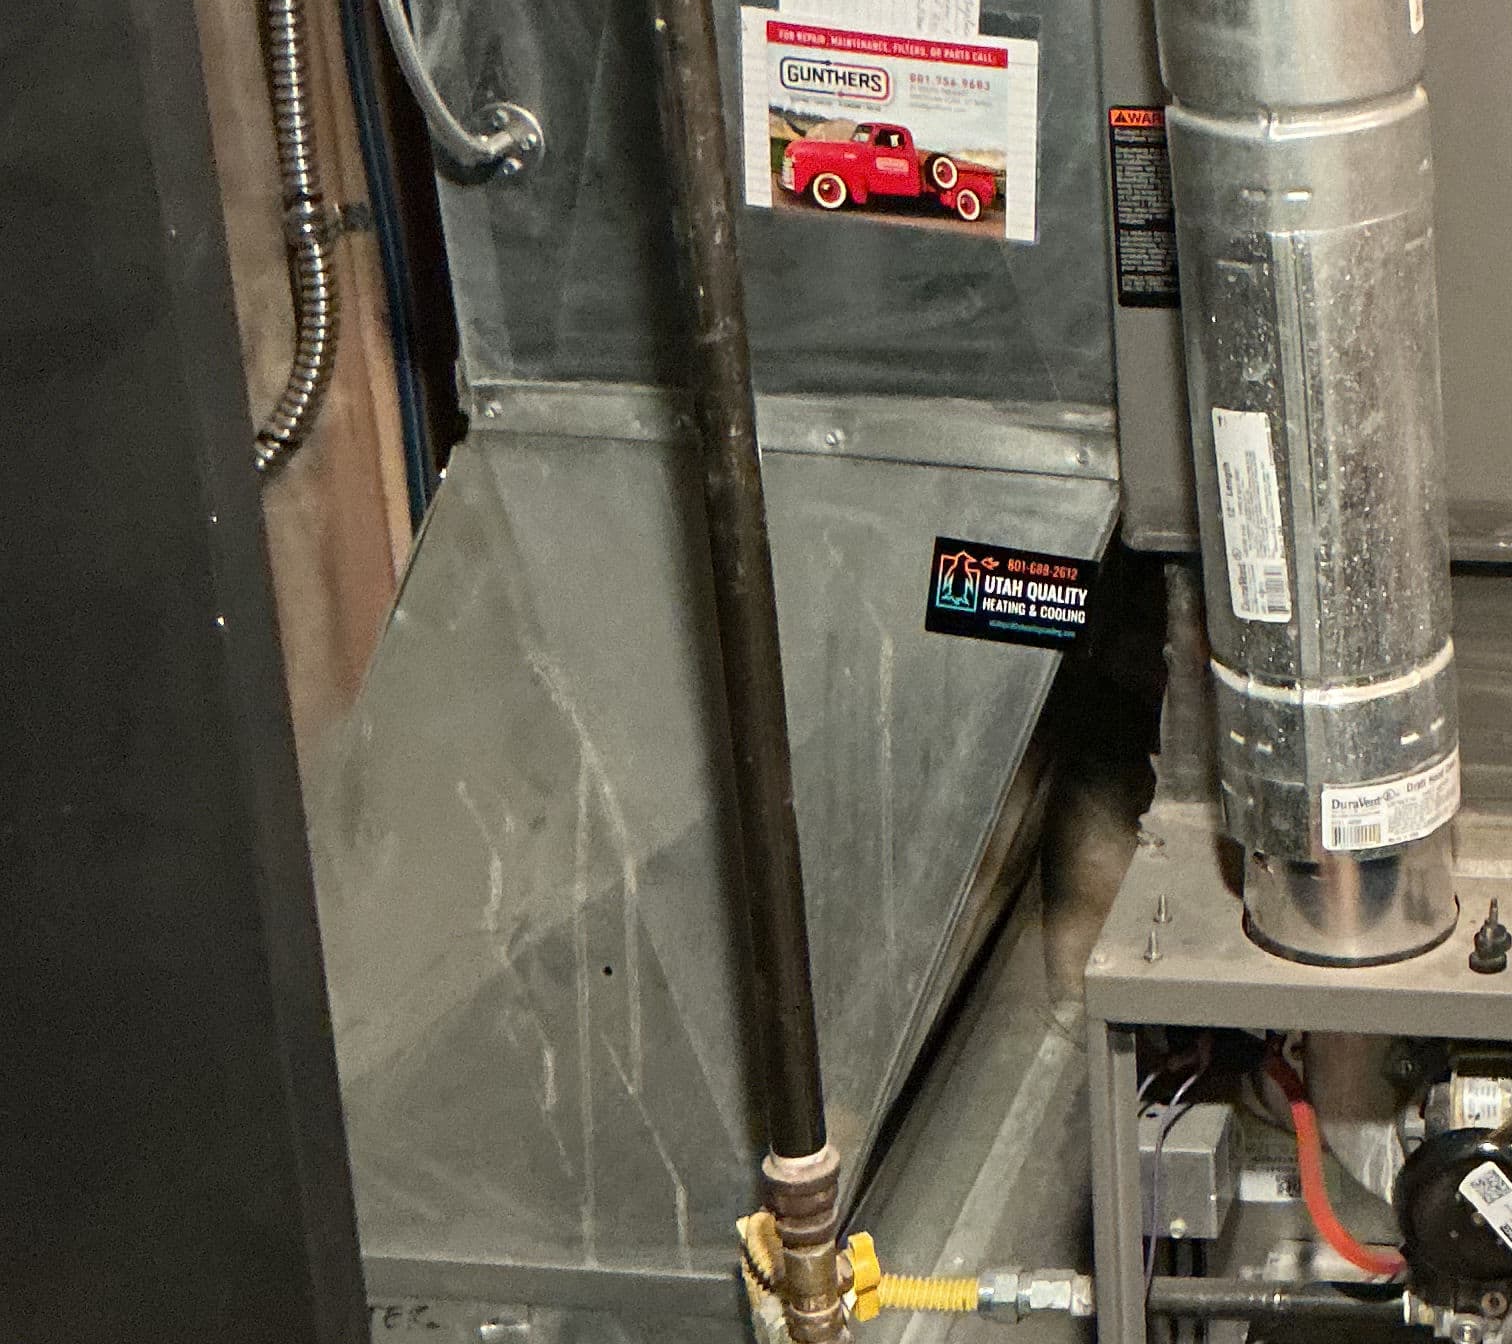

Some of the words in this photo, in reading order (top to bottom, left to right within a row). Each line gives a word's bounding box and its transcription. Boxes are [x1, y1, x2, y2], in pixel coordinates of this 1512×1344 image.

[787, 64, 883, 93] GUNTHERS
[984, 574, 1023, 598] UTAH
[1026, 581, 1088, 606] QUALITY
[982, 596, 1026, 616] HEATING
[1029, 604, 1037, 617] &
[1040, 606, 1086, 624] COOLING
[1331, 796, 1382, 811] DuraVent
